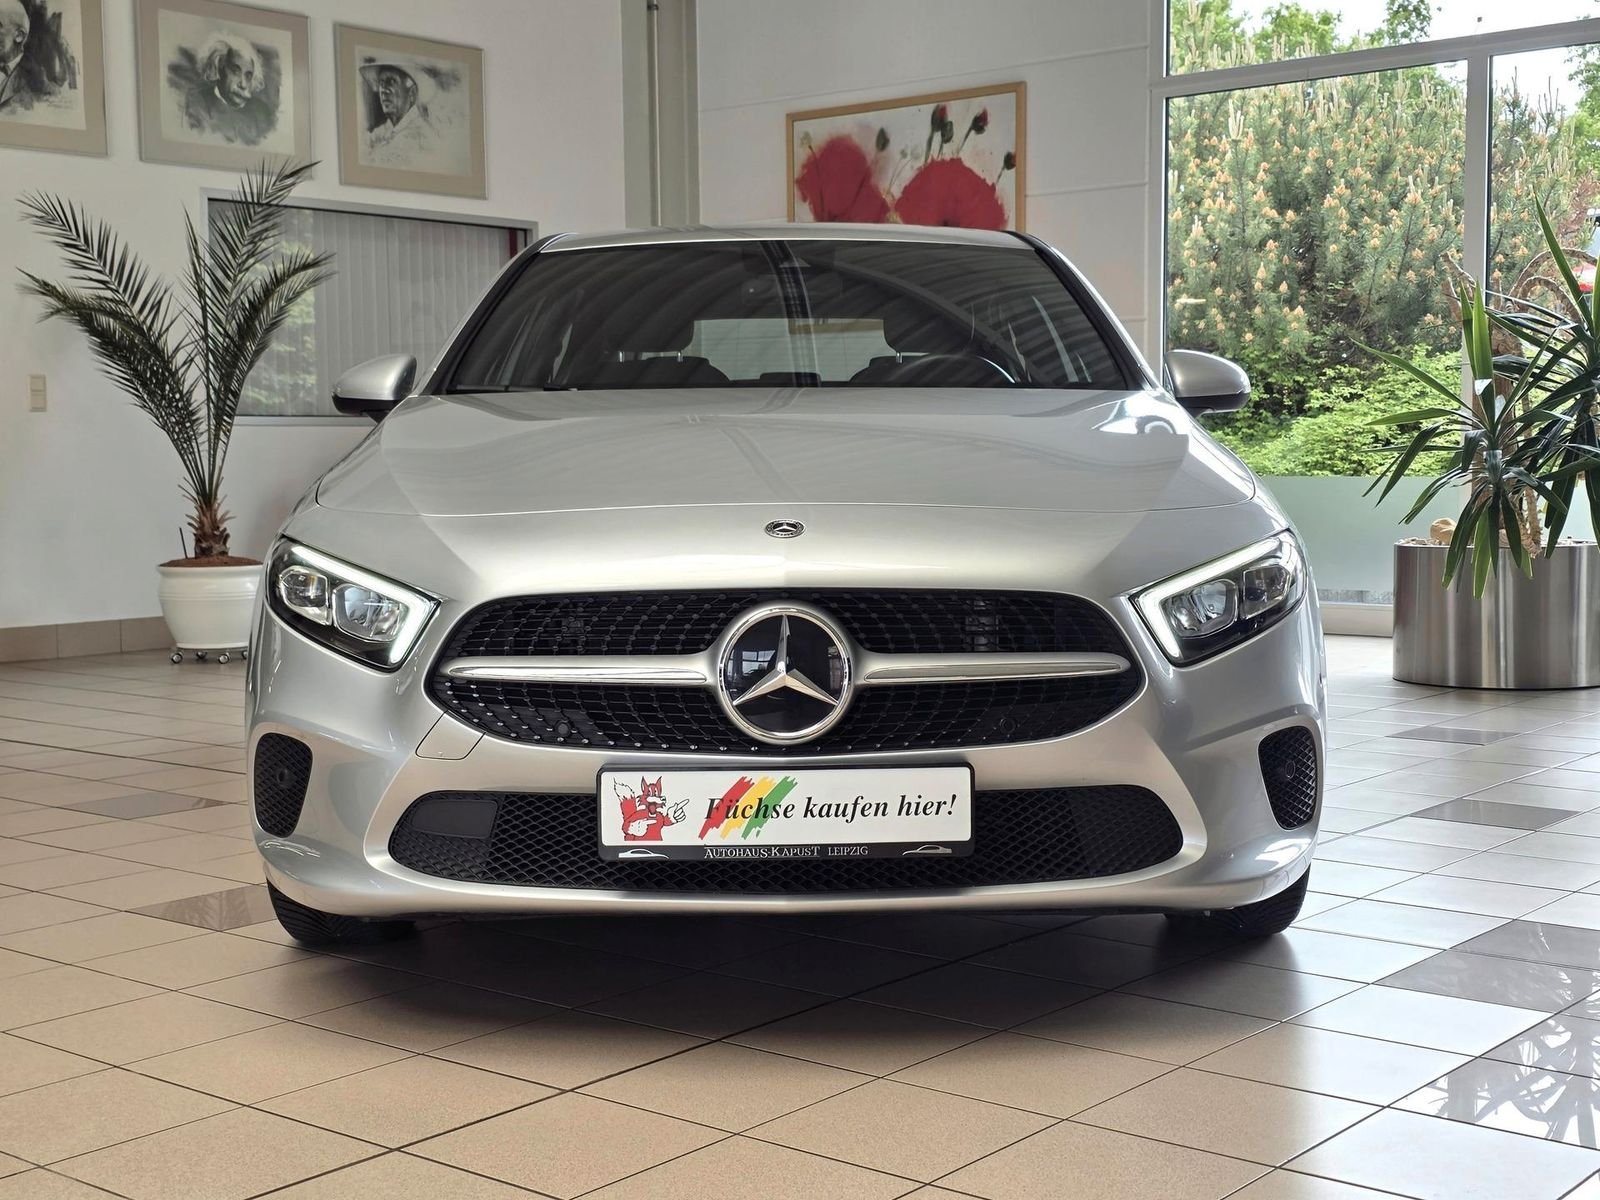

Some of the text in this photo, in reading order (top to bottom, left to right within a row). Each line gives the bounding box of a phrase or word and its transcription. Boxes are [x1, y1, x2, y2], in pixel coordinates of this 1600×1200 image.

[704, 793, 957, 824] Füchse kaufen hier!
[828, 846, 869, 856] LEIPZIG
